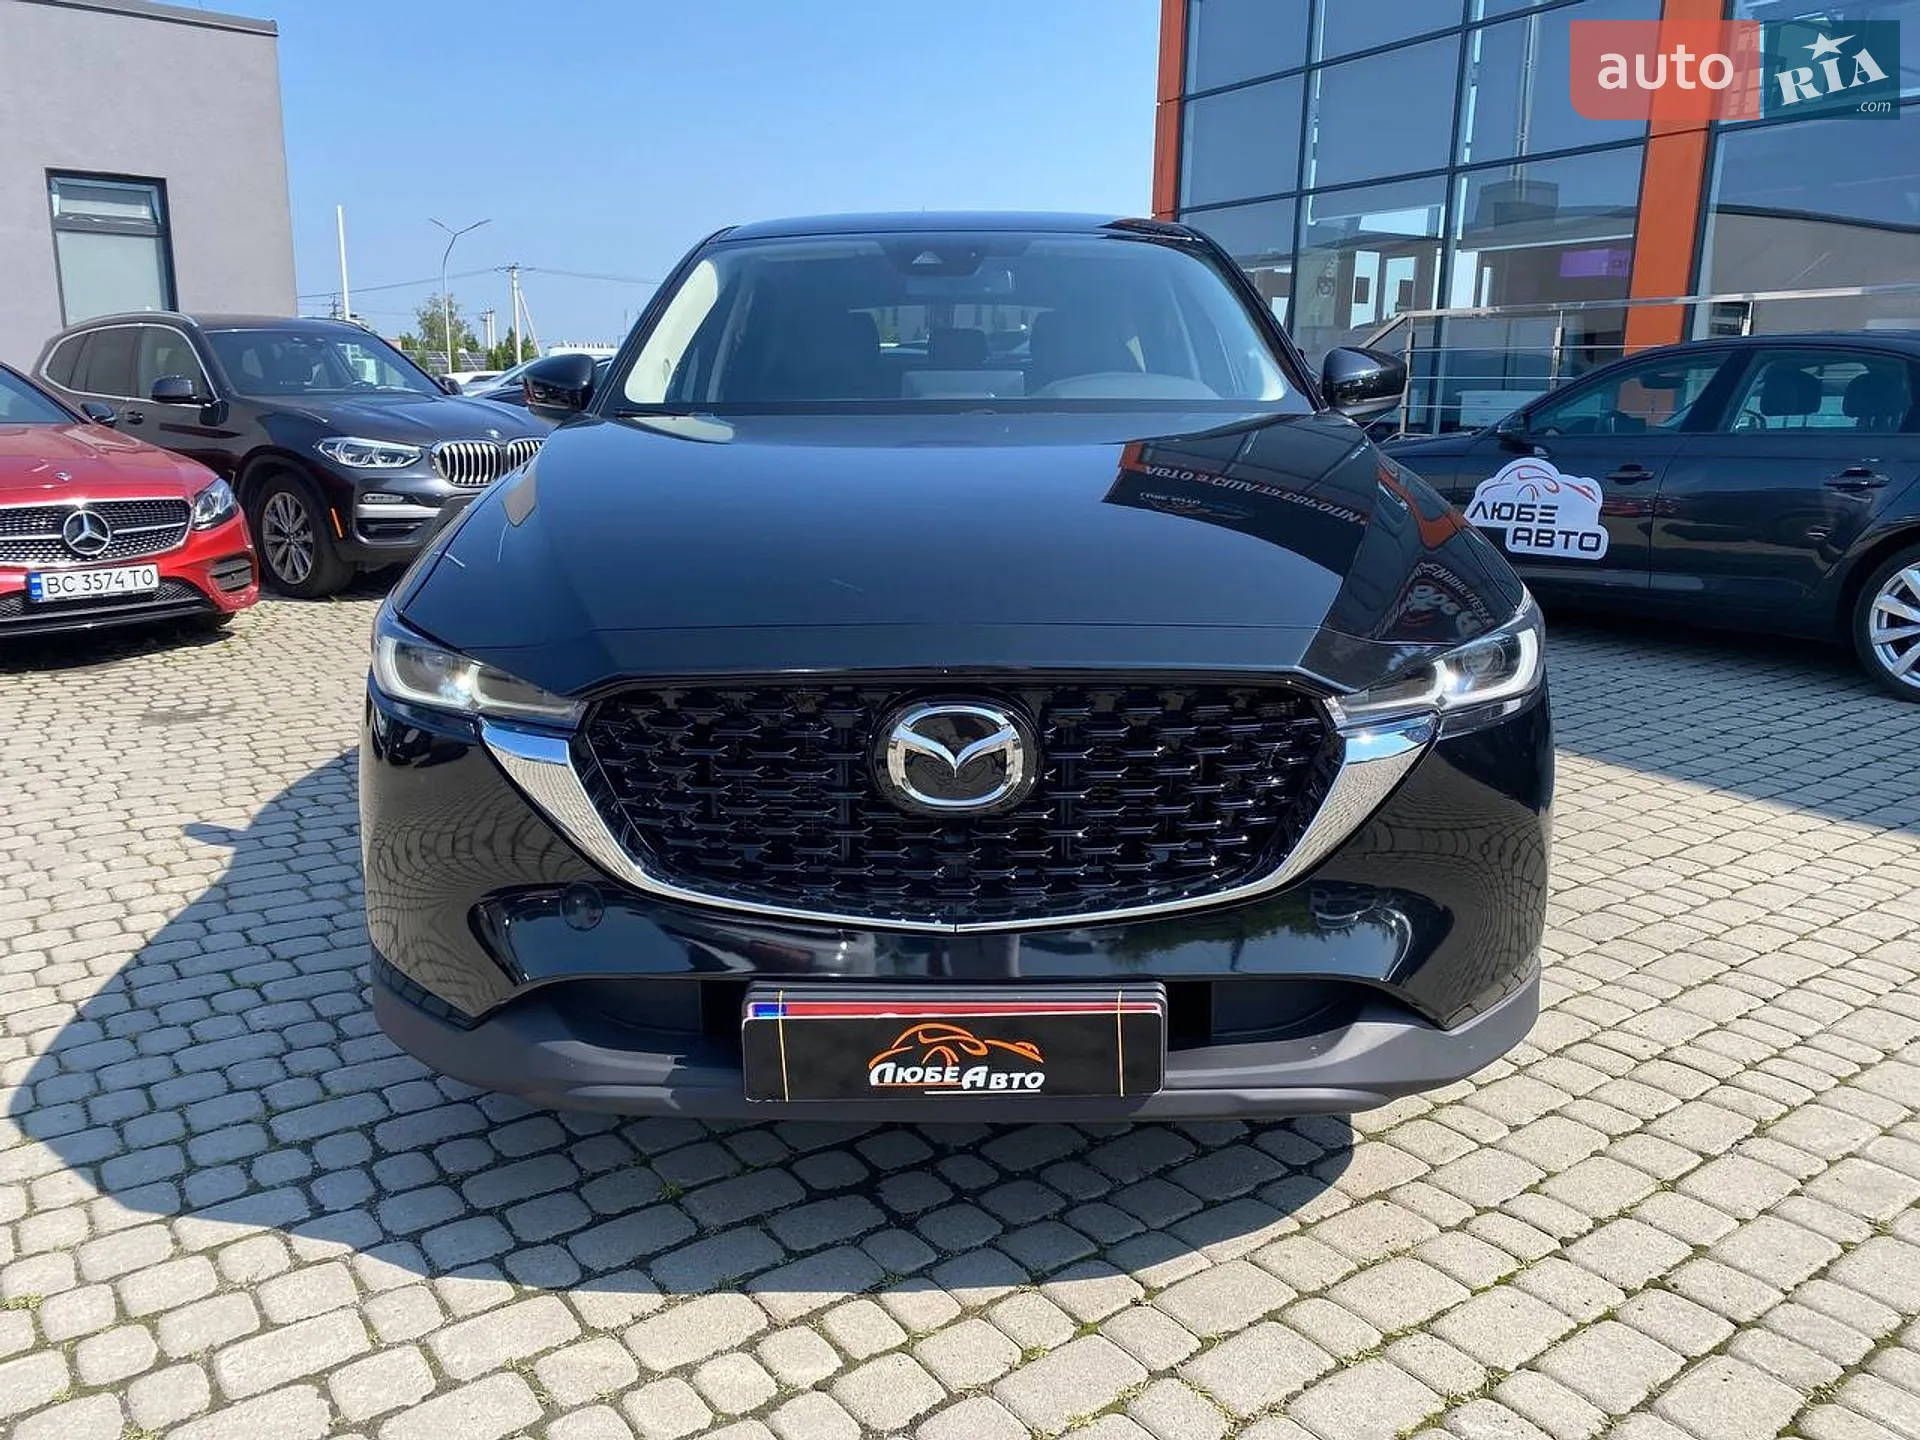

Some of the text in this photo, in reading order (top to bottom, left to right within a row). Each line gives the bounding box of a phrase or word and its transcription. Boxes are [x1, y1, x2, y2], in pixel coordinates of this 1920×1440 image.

[1470, 501, 1558, 524] ЛЮБЕ
[1512, 527, 1601, 551] АВТО
[47, 569, 153, 594] BC 3574 TO
